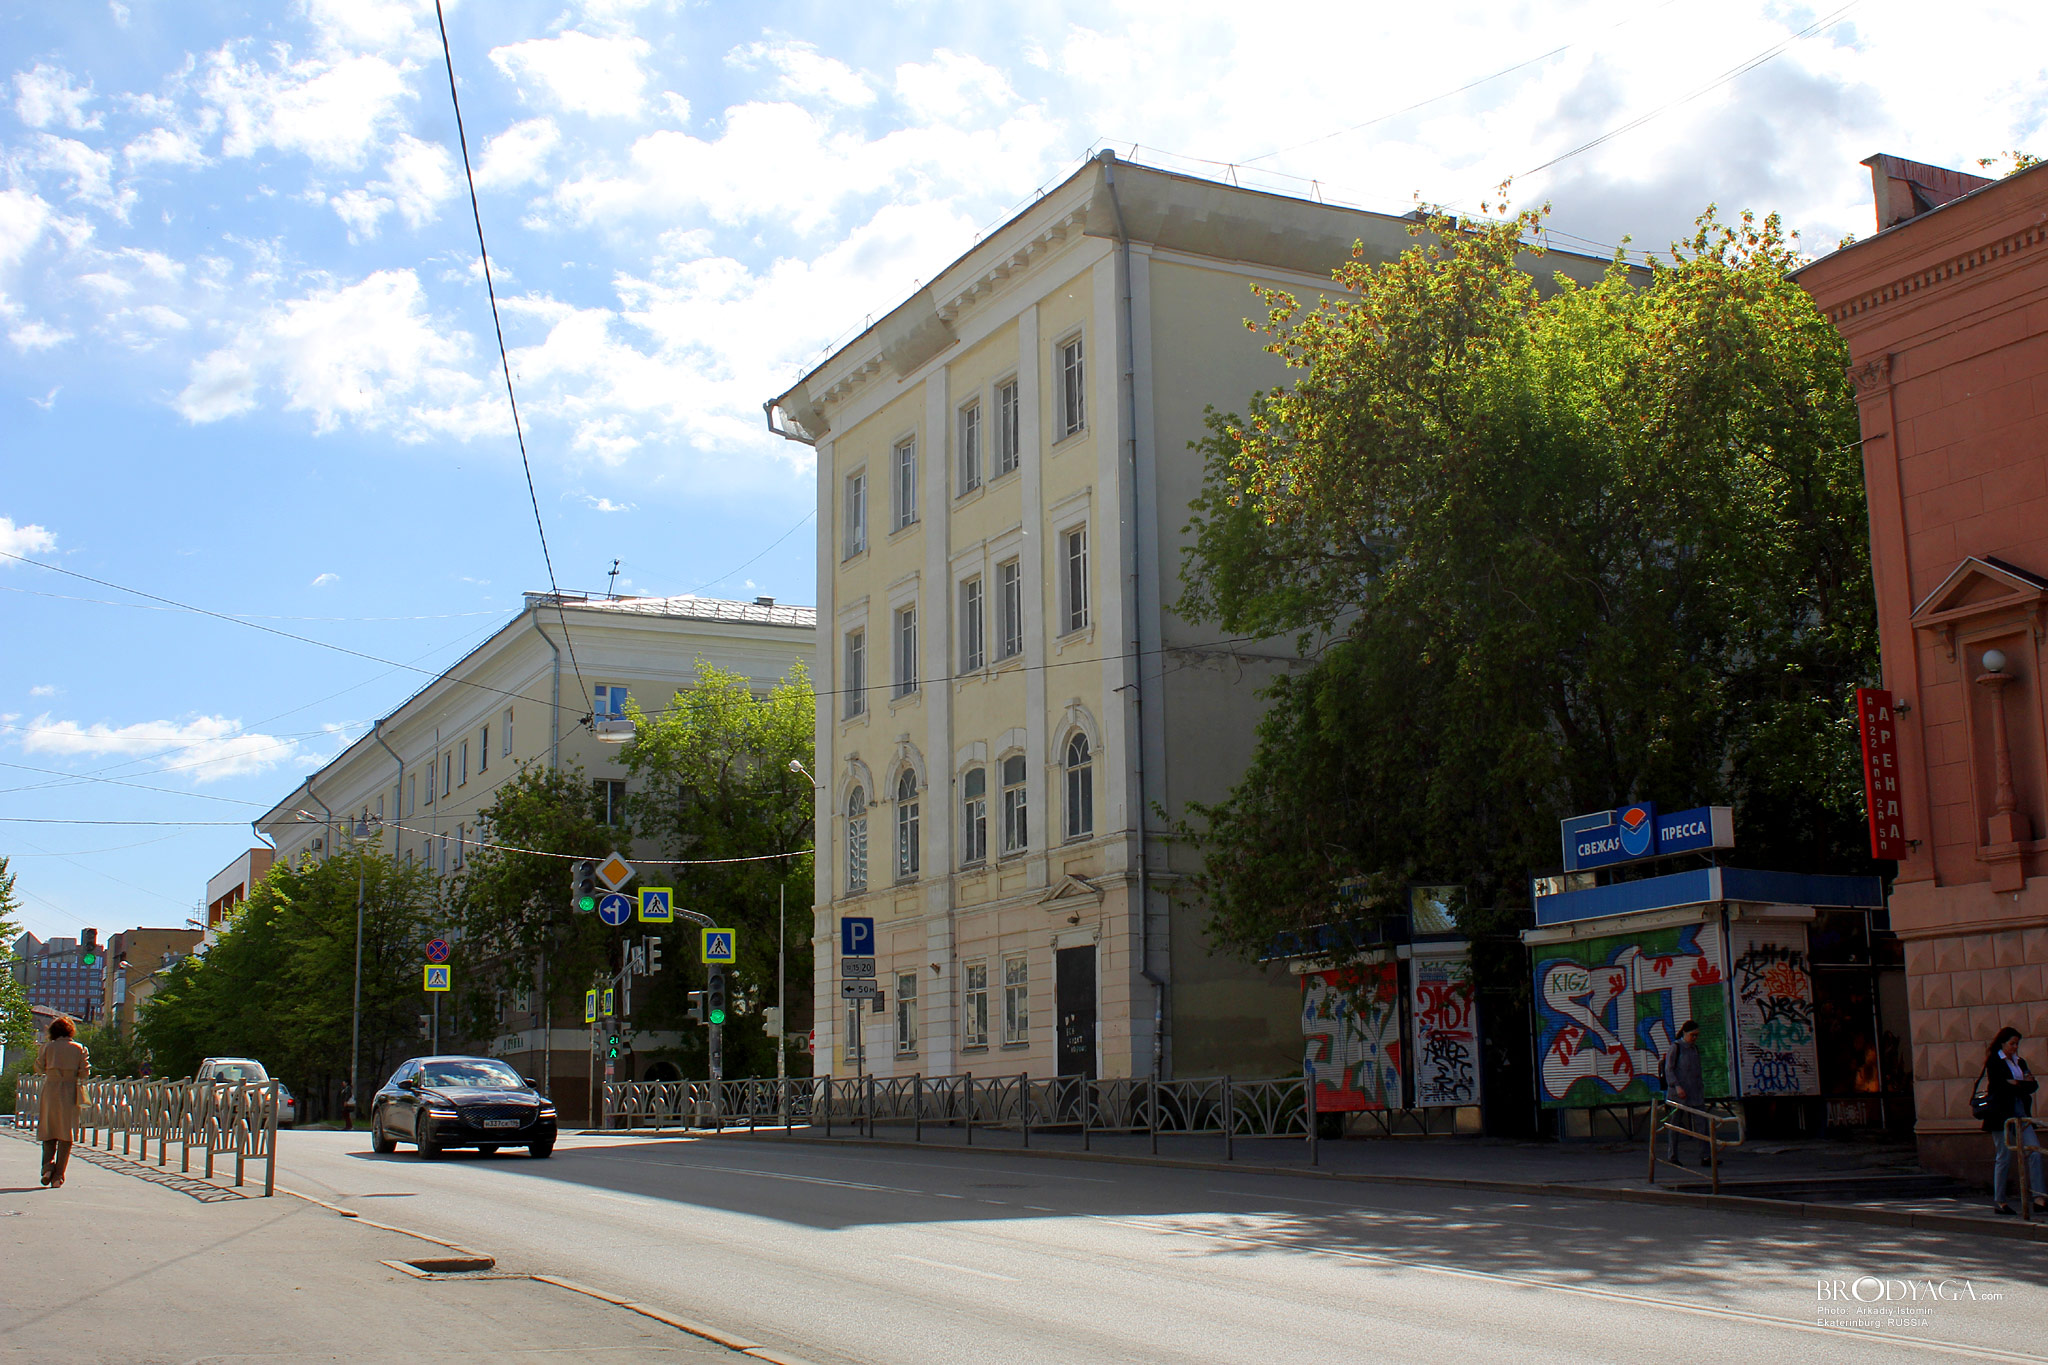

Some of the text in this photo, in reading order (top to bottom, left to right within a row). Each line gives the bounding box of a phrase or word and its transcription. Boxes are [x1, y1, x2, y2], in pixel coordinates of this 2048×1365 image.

[1878, 707, 1900, 839] АРЕНДА
[1578, 821, 1707, 857] СВЕЖАЯ ПРЕССА
[851, 922, 868, 951] P
[861, 963, 872, 972] 20
[1551, 972, 1589, 994] KIGZ
